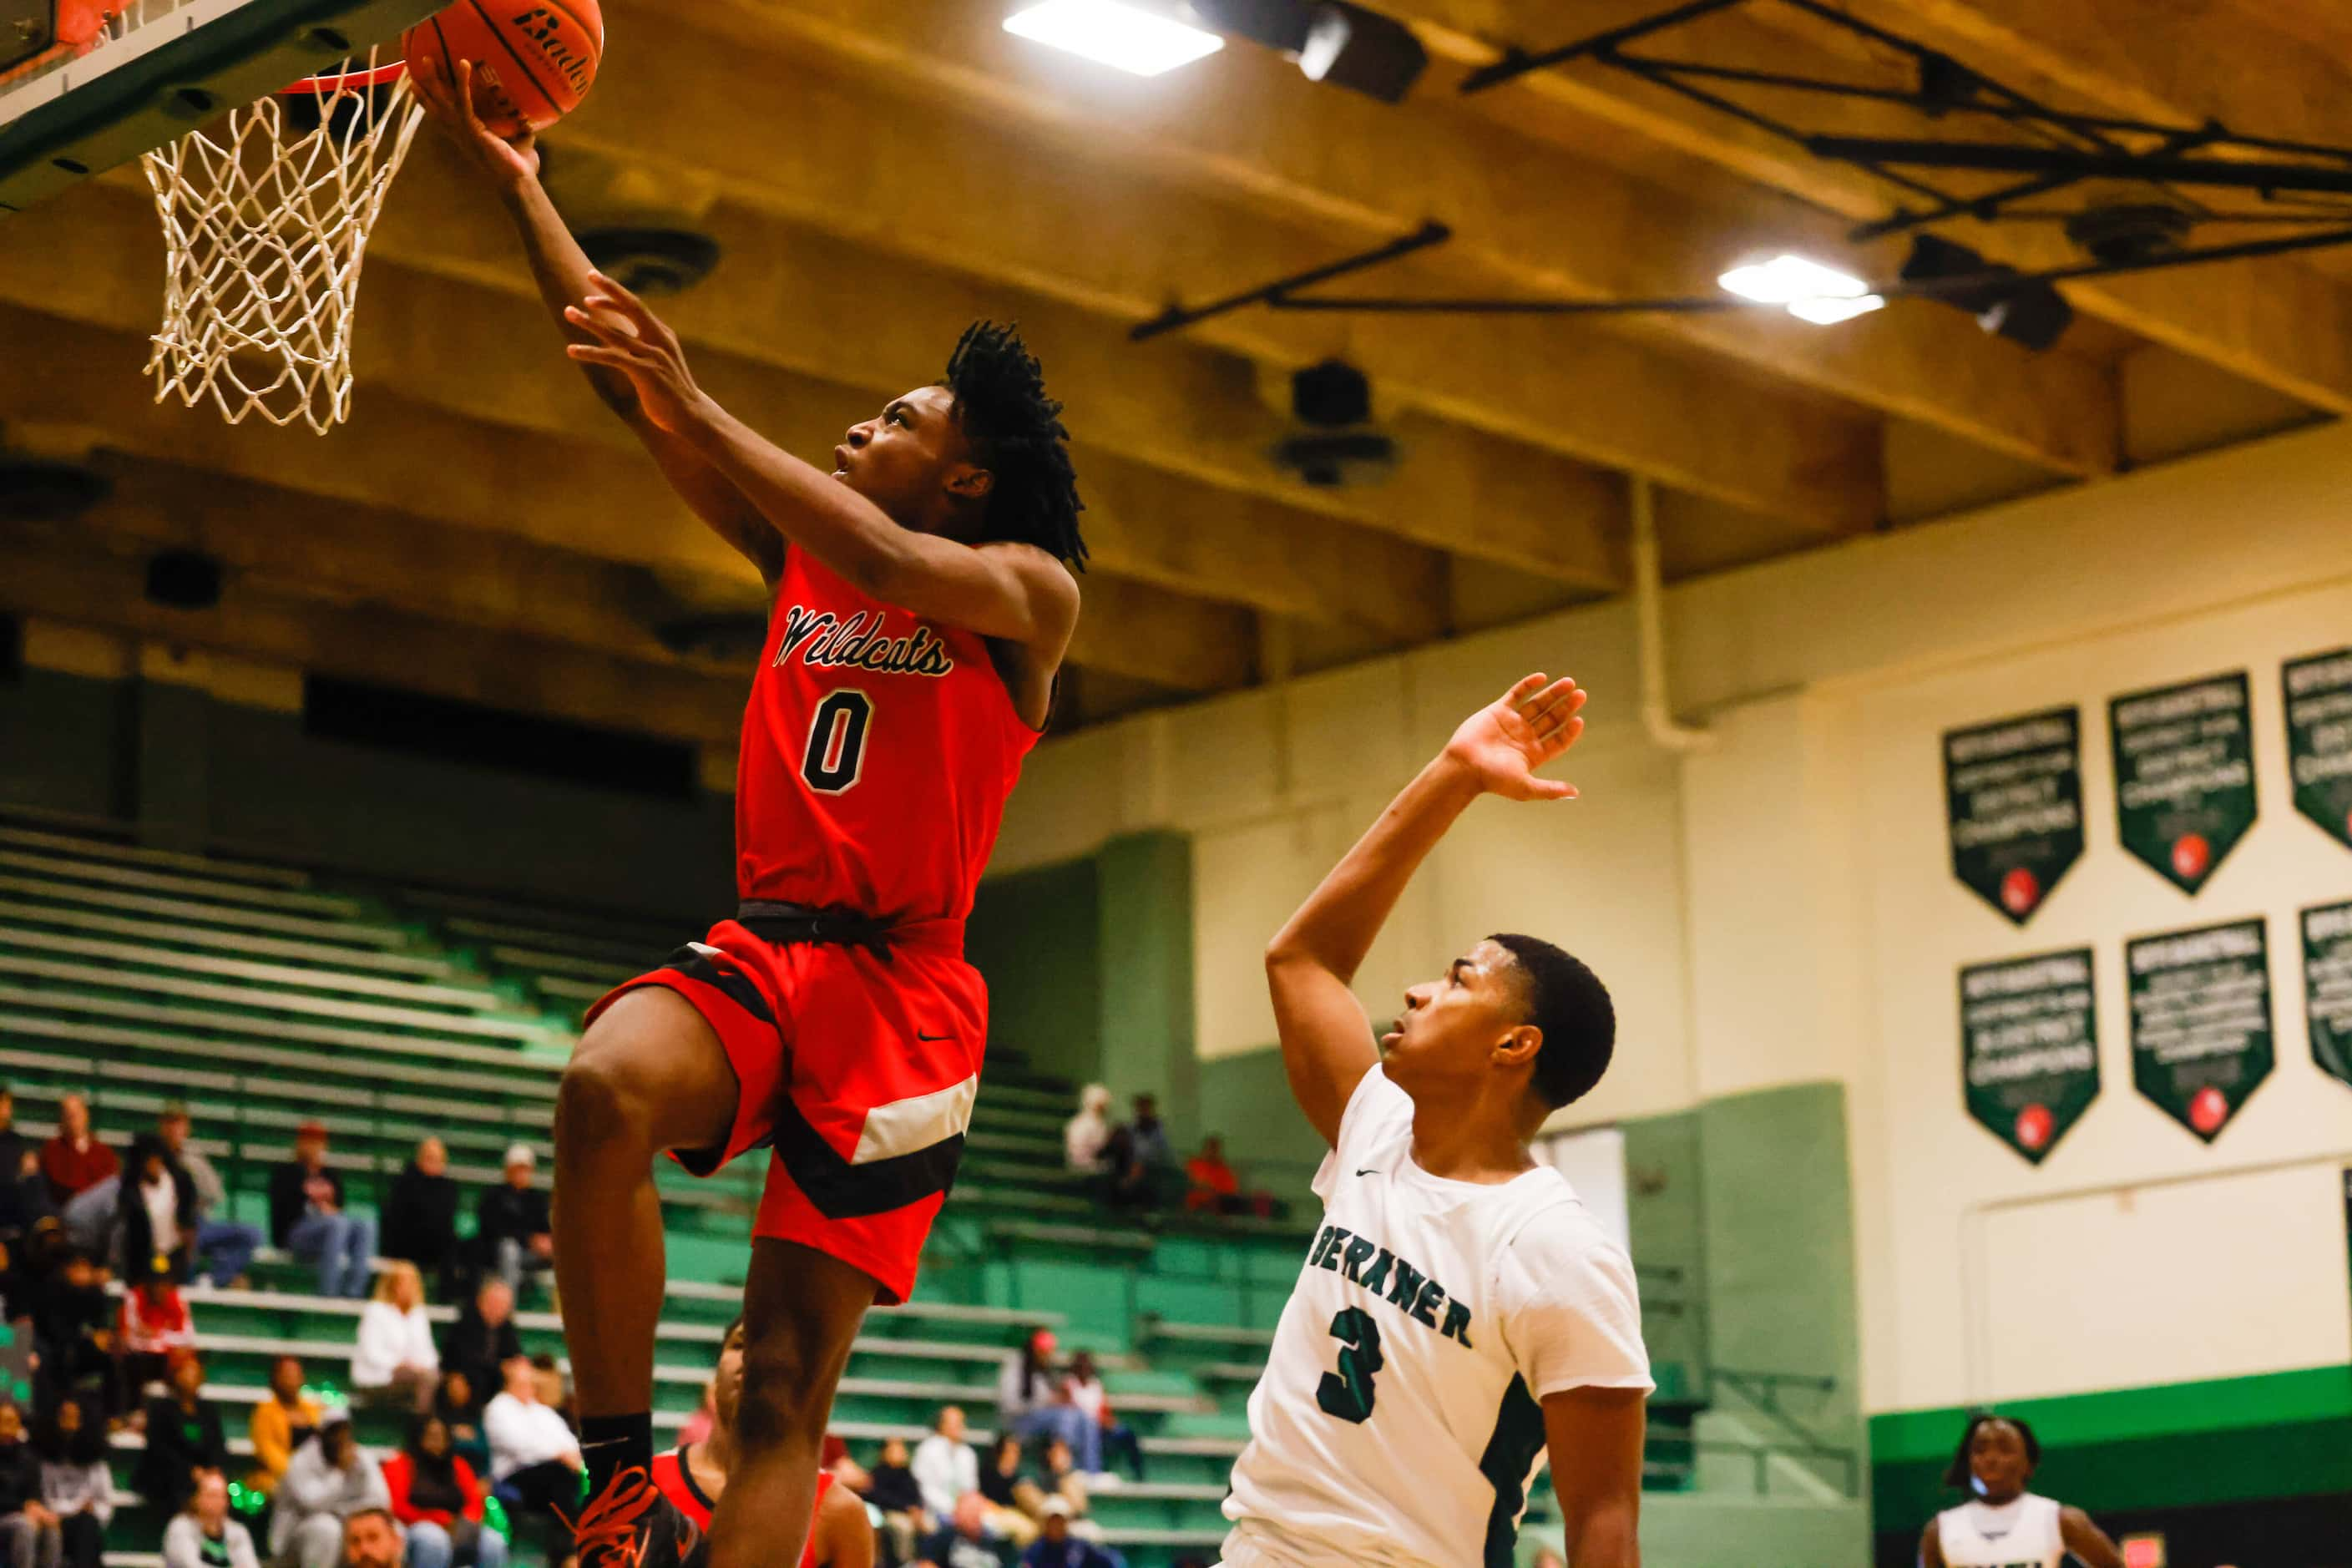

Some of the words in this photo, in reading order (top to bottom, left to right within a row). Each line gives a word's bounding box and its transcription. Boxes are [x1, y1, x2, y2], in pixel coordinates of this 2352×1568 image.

[771, 604, 954, 678] Wildcats
[799, 687, 875, 797] 0
[1316, 1306, 1384, 1425] 3
